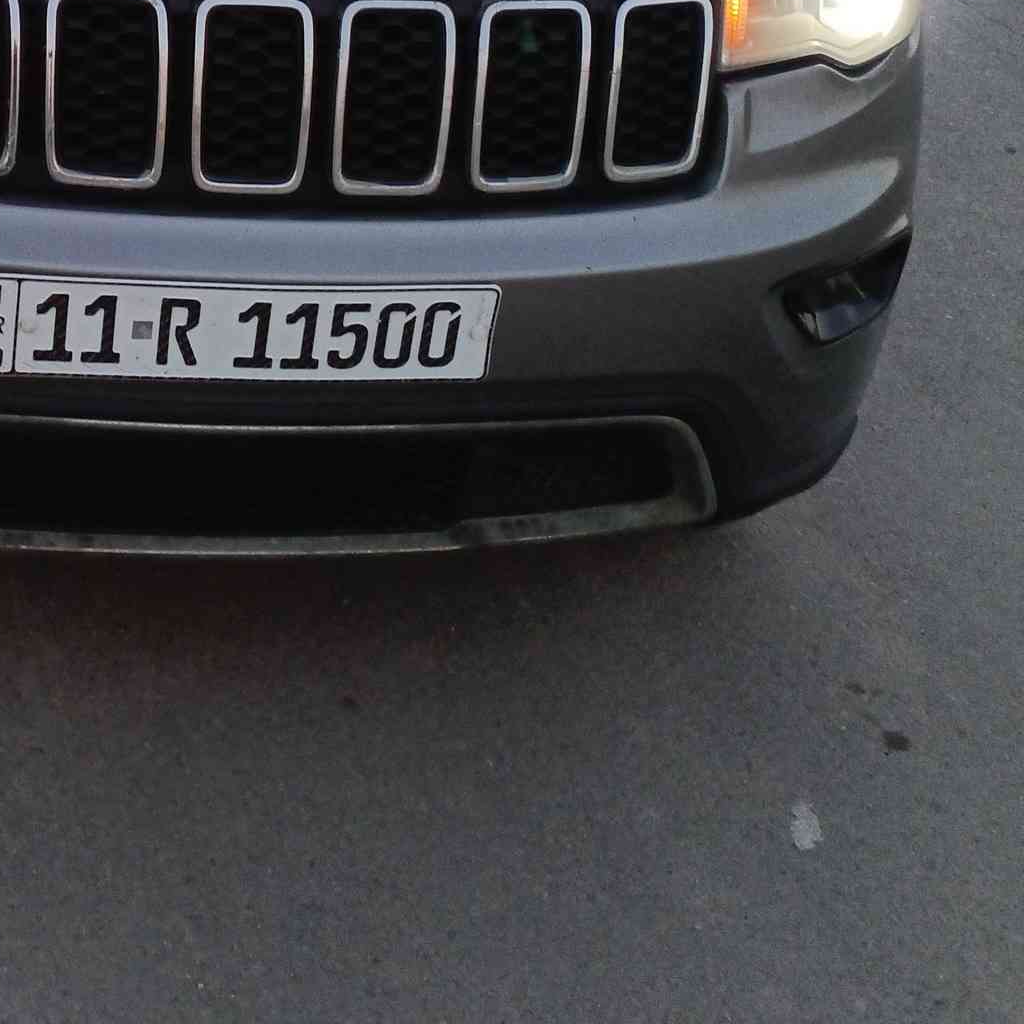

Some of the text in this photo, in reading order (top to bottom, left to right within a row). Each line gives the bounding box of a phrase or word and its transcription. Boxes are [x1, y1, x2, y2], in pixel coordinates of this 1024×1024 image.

[32, 293, 461, 370] 11 R 11500
